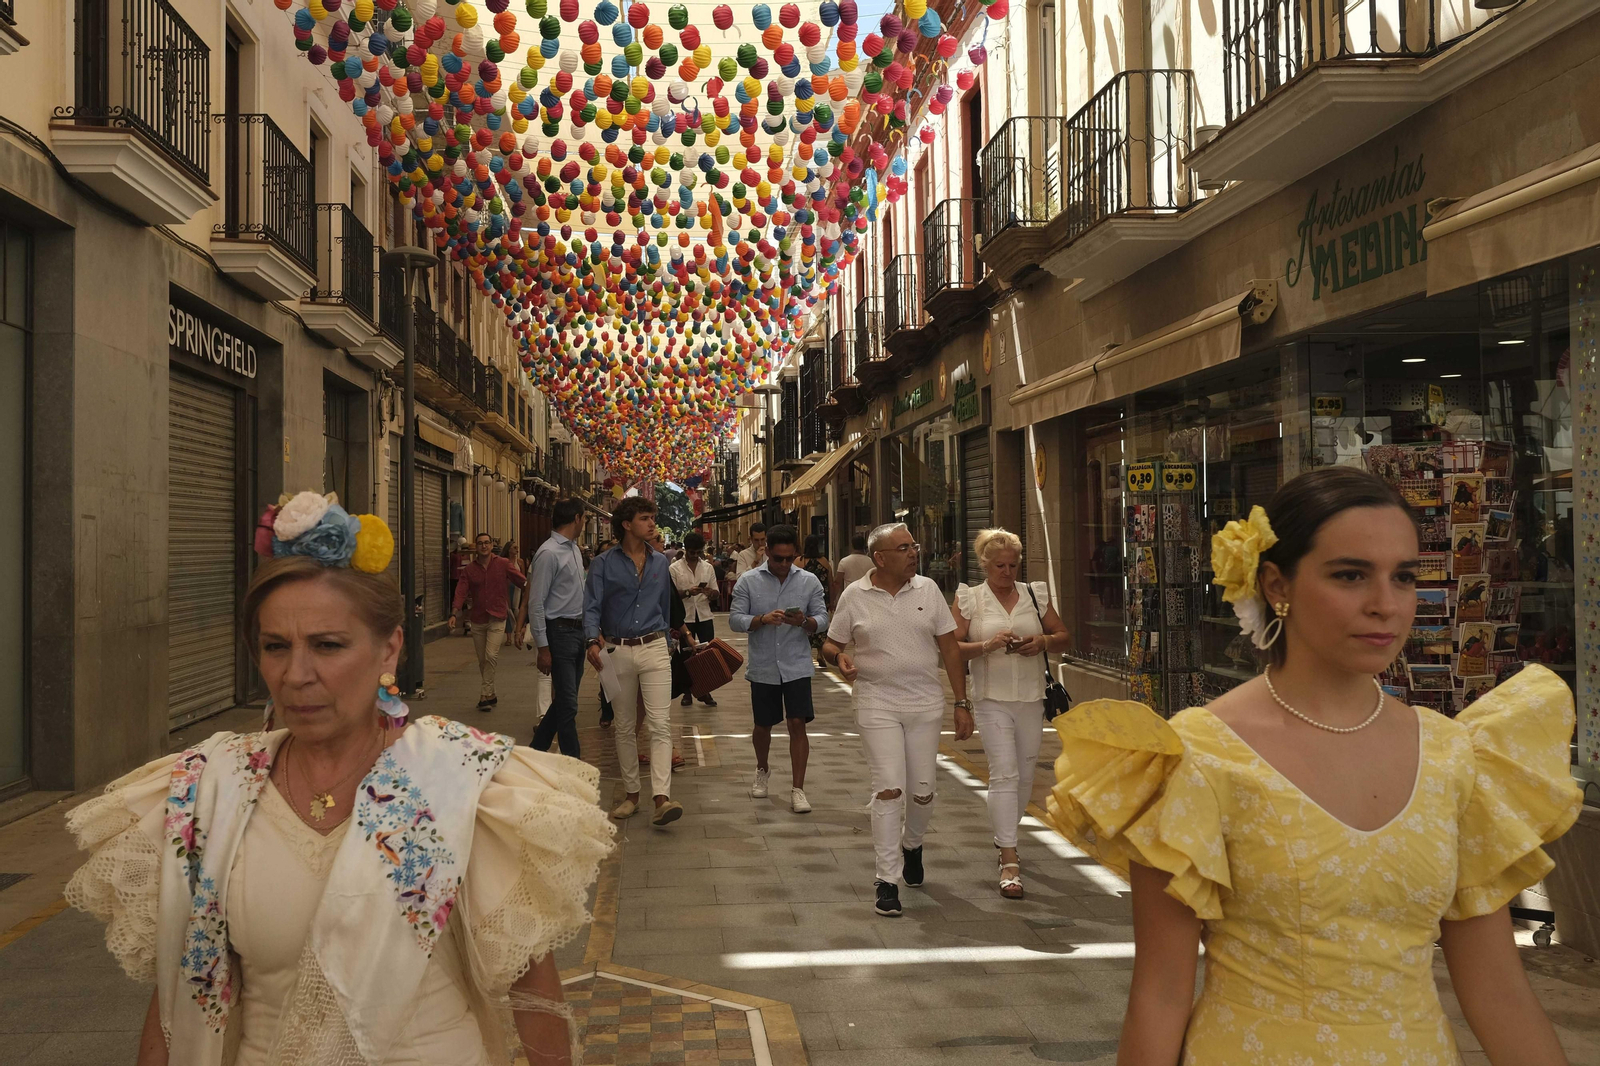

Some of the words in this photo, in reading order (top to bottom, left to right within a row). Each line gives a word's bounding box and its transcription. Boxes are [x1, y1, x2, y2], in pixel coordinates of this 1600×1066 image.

[1286, 146, 1426, 288] Artesanías
[169, 304, 257, 379] SPRINGFIELD
[1317, 399, 1341, 410] 2.95
[1130, 472, 1152, 487] 0,30
[1165, 472, 1193, 486] 0,30
